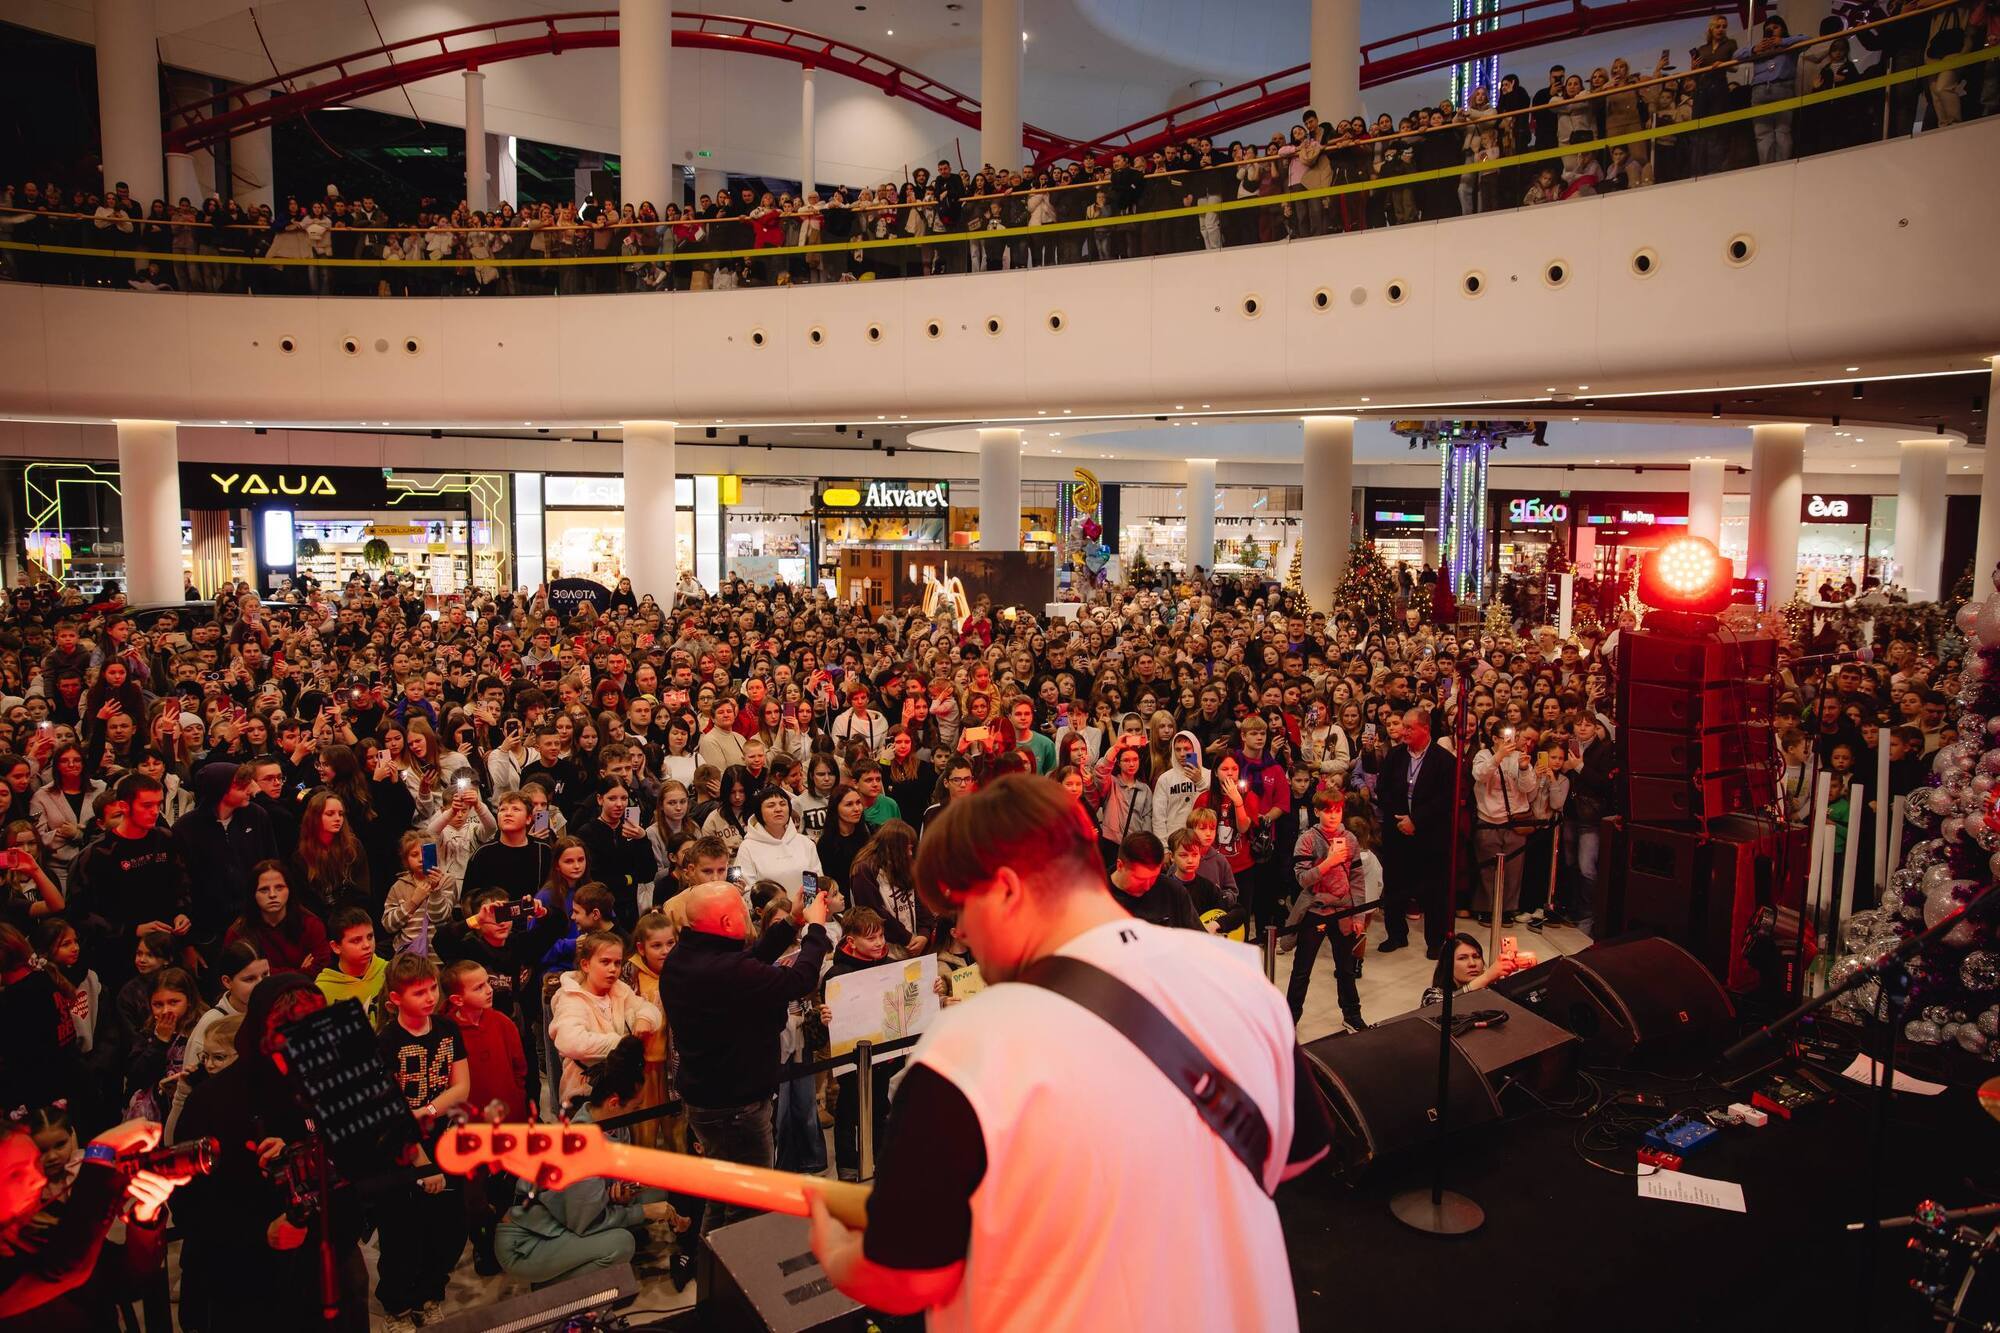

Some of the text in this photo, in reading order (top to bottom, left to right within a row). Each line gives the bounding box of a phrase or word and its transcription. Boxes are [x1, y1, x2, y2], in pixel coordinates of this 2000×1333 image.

[211, 473, 336, 495] YA.UA
[866, 482, 949, 507] Akvarel
[1510, 497, 1567, 523] Ябко
[552, 589, 597, 600] ЗОЛОТА
[806, 808, 828, 829] TO
